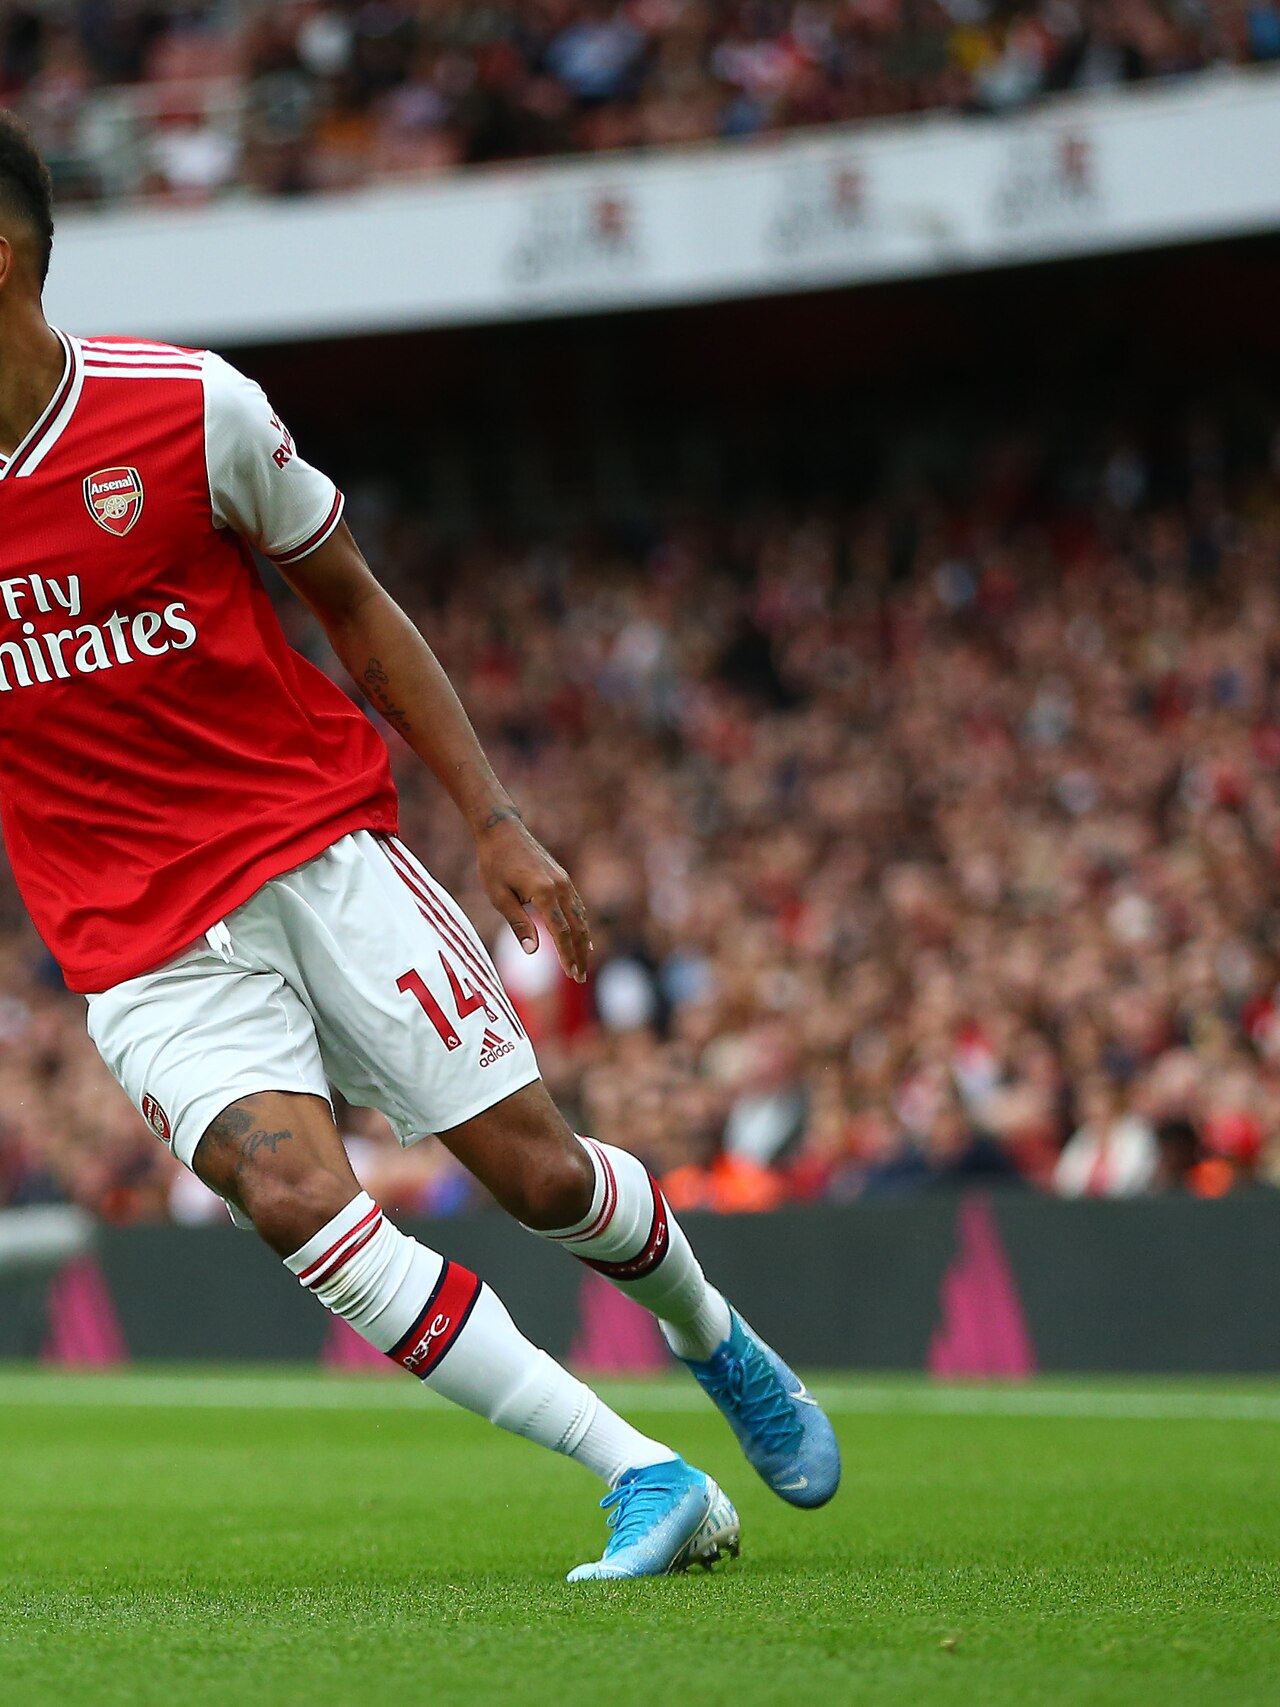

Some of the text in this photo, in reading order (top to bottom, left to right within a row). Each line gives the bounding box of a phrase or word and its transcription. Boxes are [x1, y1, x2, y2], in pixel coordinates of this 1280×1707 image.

[91, 475, 133, 495] Arsenal
[395, 949, 499, 1052] 14
[479, 1041, 516, 1068] adidas
